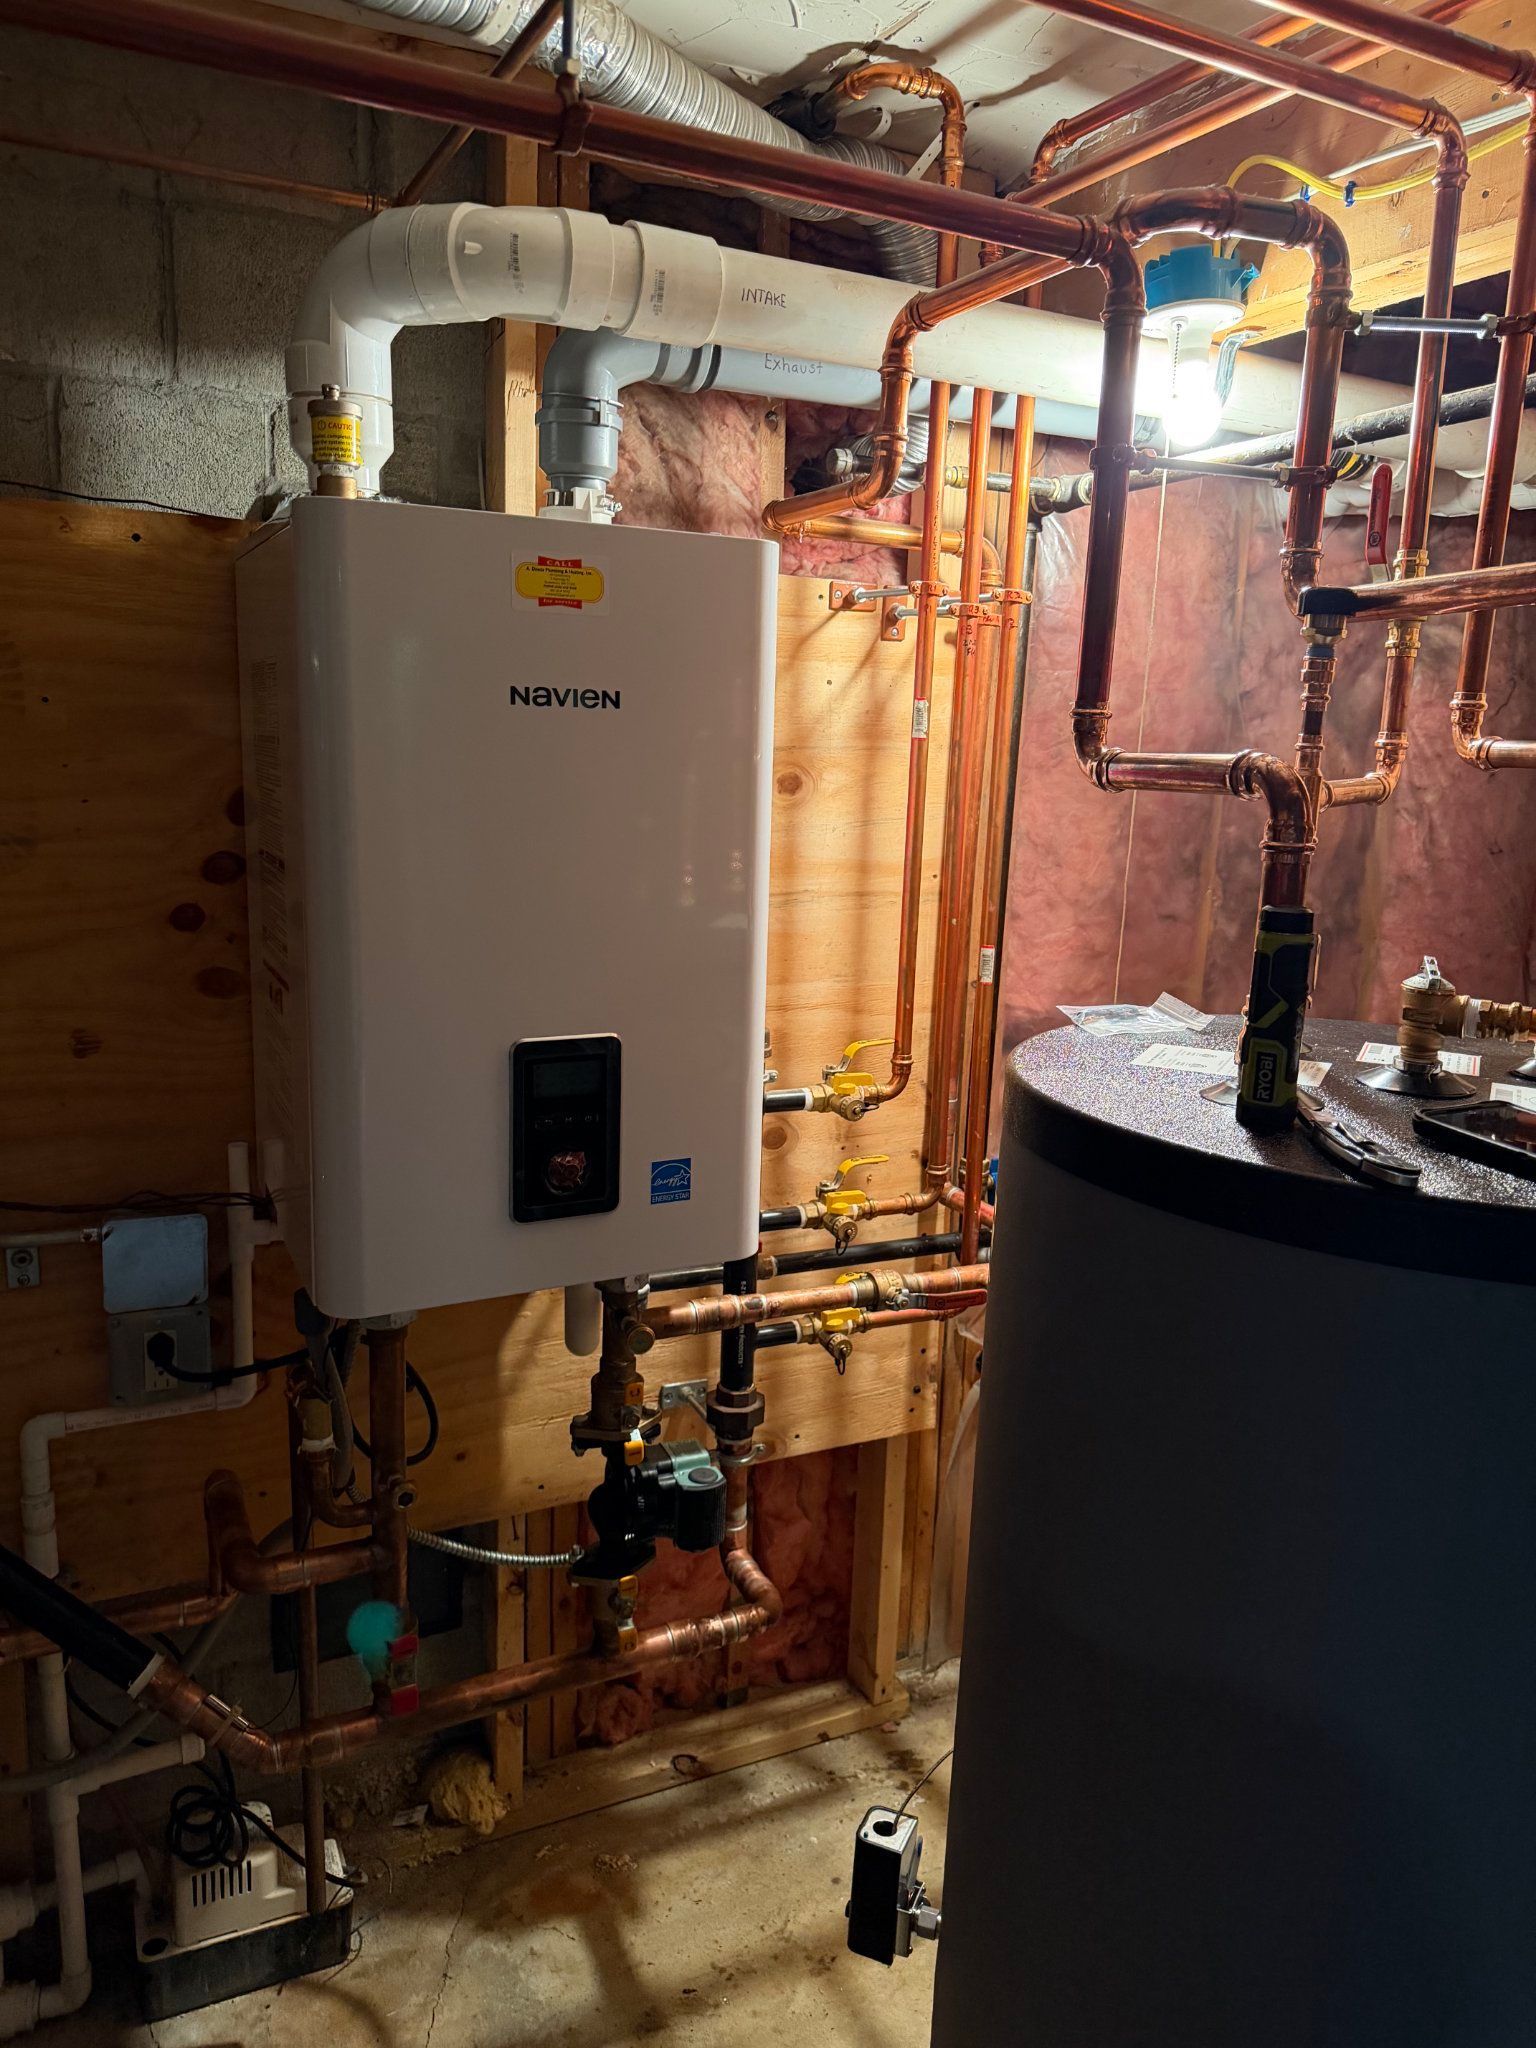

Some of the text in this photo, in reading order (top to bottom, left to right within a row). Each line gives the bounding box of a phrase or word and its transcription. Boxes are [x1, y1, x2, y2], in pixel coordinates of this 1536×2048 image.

[741, 287, 787, 309] INTAKE
[764, 352, 823, 374] Exhaust
[327, 422, 353, 431] CAUTIO
[546, 559, 574, 567] CALL
[1255, 1055, 1274, 1101] RYOBI
[652, 1191, 690, 1203] ENERGY STAR
